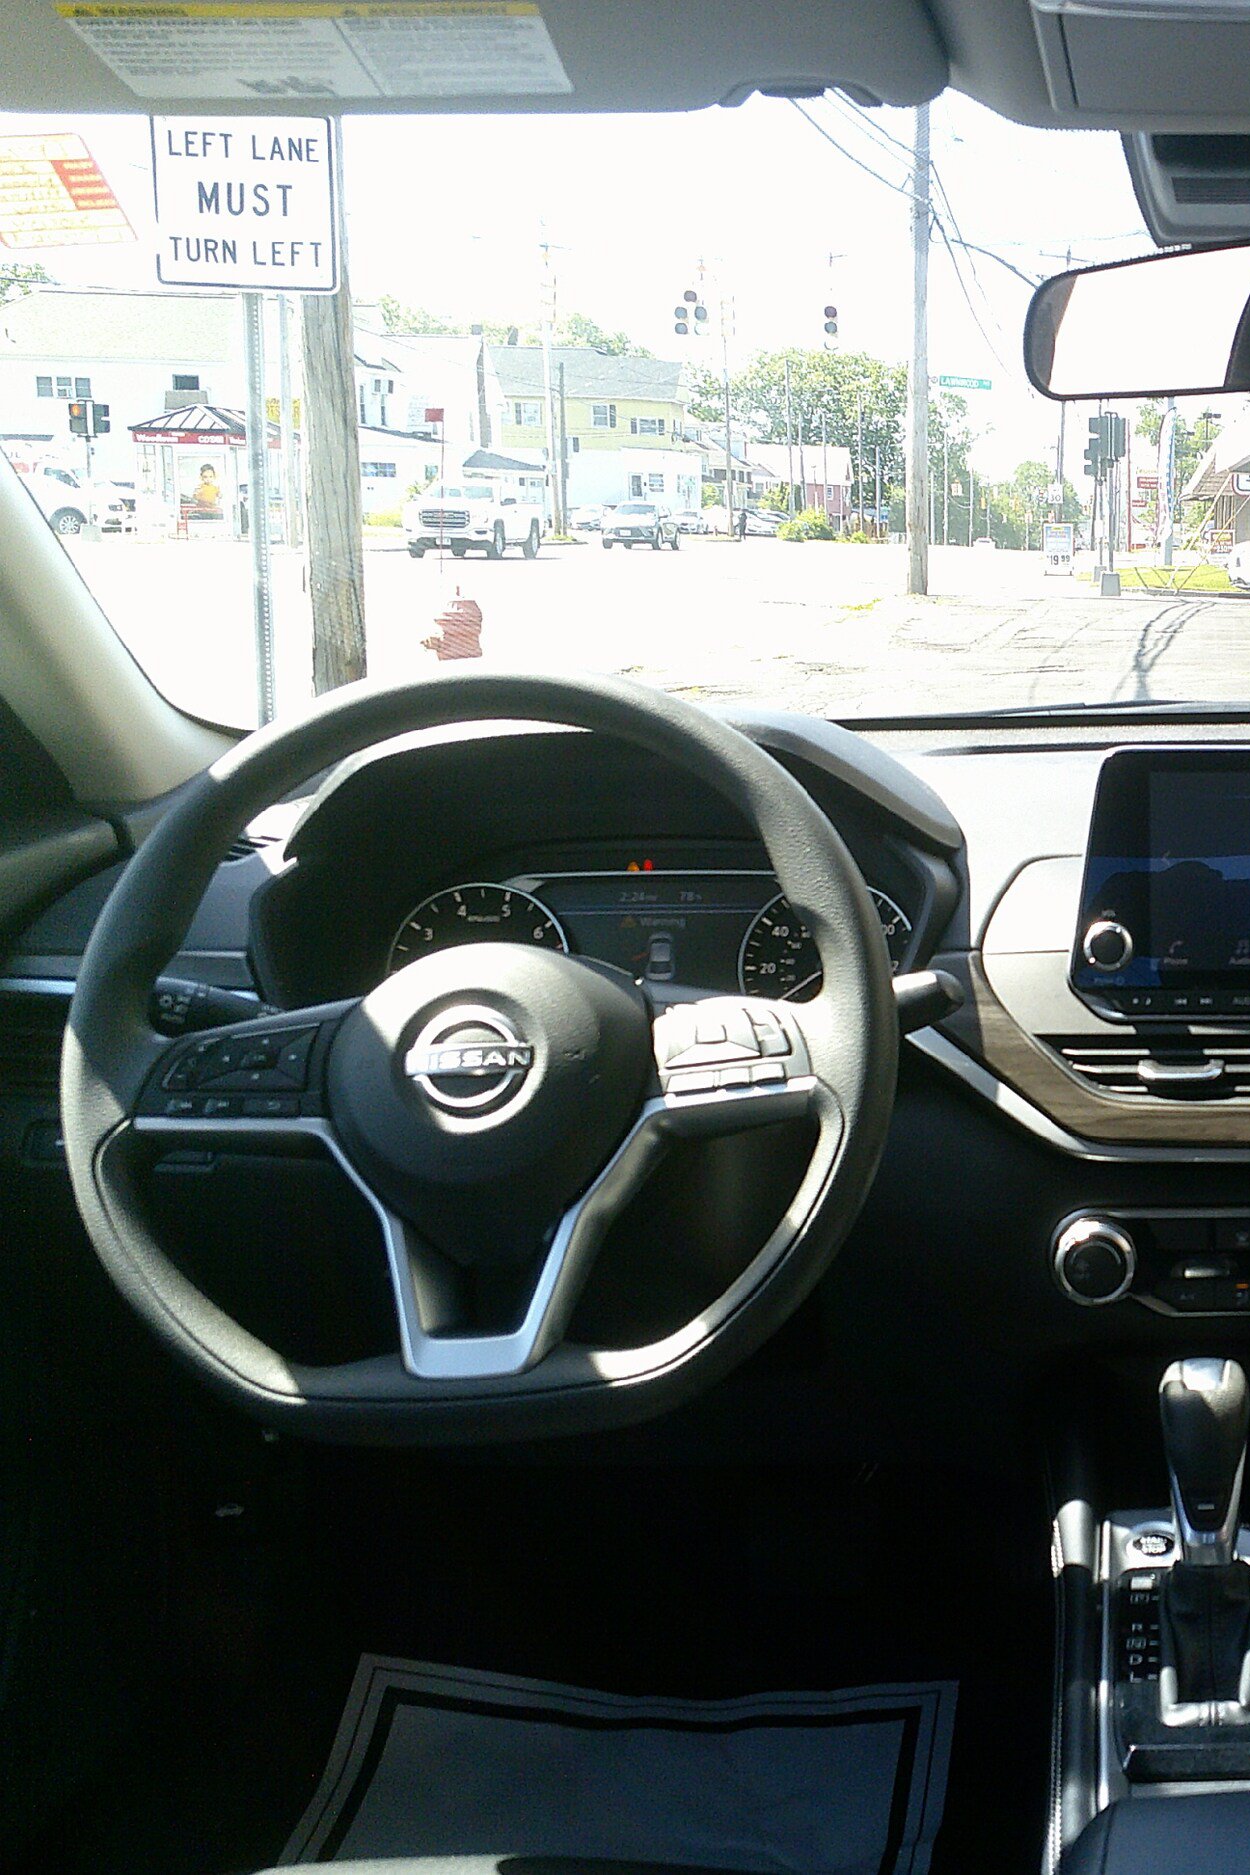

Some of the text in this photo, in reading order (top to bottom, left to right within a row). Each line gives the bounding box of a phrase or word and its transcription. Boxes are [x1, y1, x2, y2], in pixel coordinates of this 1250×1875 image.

[168, 130, 319, 162] LEFT LANE
[198, 181, 292, 217] MUST
[169, 236, 322, 267] TURN LEFT
[456, 904, 467, 917] 4
[501, 904, 511, 918] 5
[424, 927, 434, 942] 3
[533, 926, 544, 940] 6
[771, 925, 790, 938] 40
[759, 962, 776, 975] 20
[1129, 1671, 1143, 1684] L
